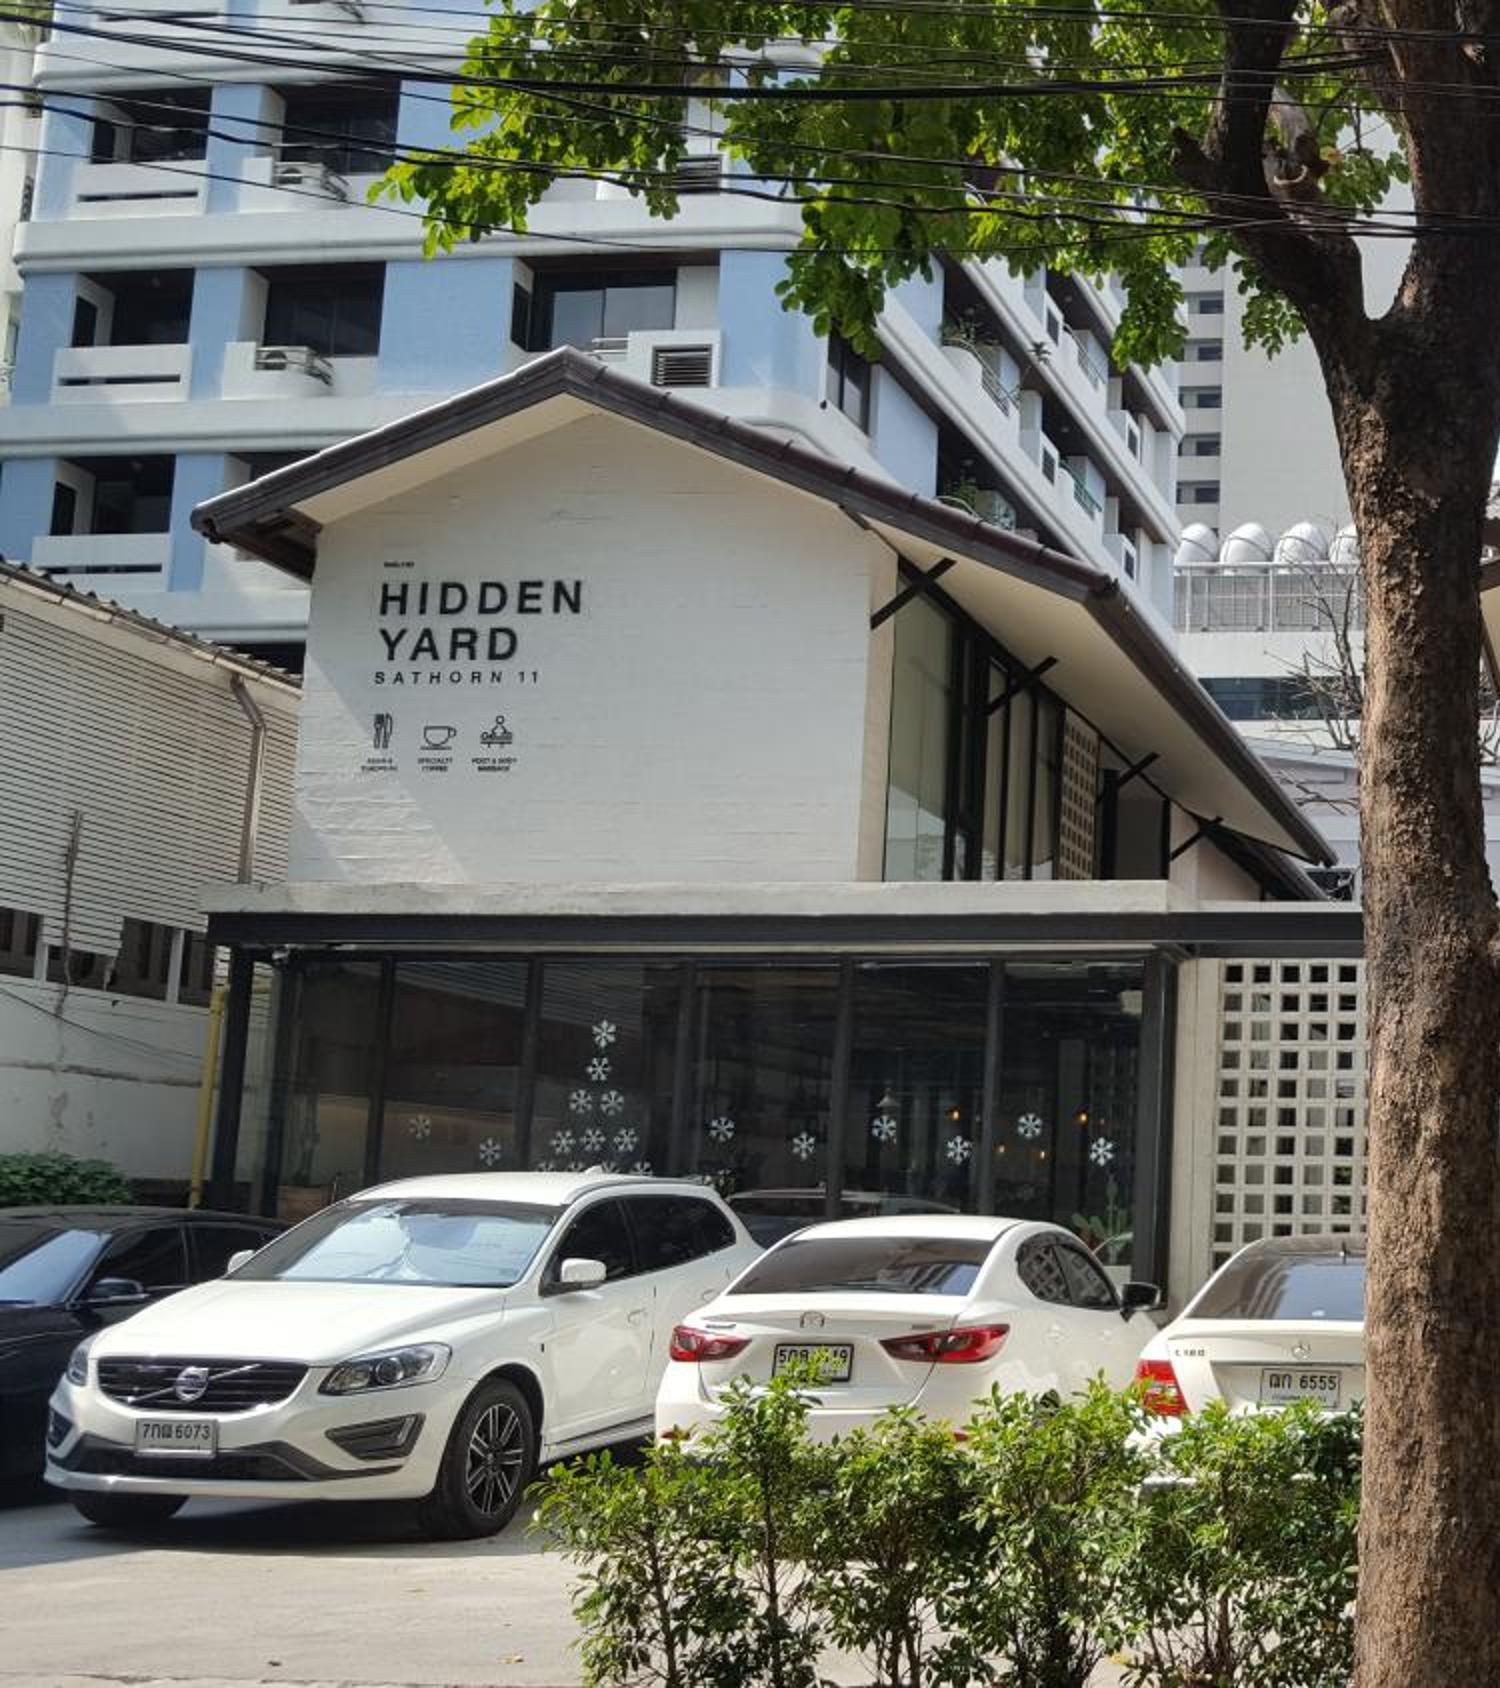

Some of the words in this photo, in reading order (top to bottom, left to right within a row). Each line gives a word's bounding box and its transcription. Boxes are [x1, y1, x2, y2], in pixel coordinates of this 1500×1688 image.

[380, 580, 582, 616] HIDDEN
[379, 627, 519, 662] YARD
[374, 671, 502, 685] SATHORN
[518, 671, 540, 684] 11
[1300, 1375, 1337, 1391] 6555
[175, 1423, 210, 1441] 6073
